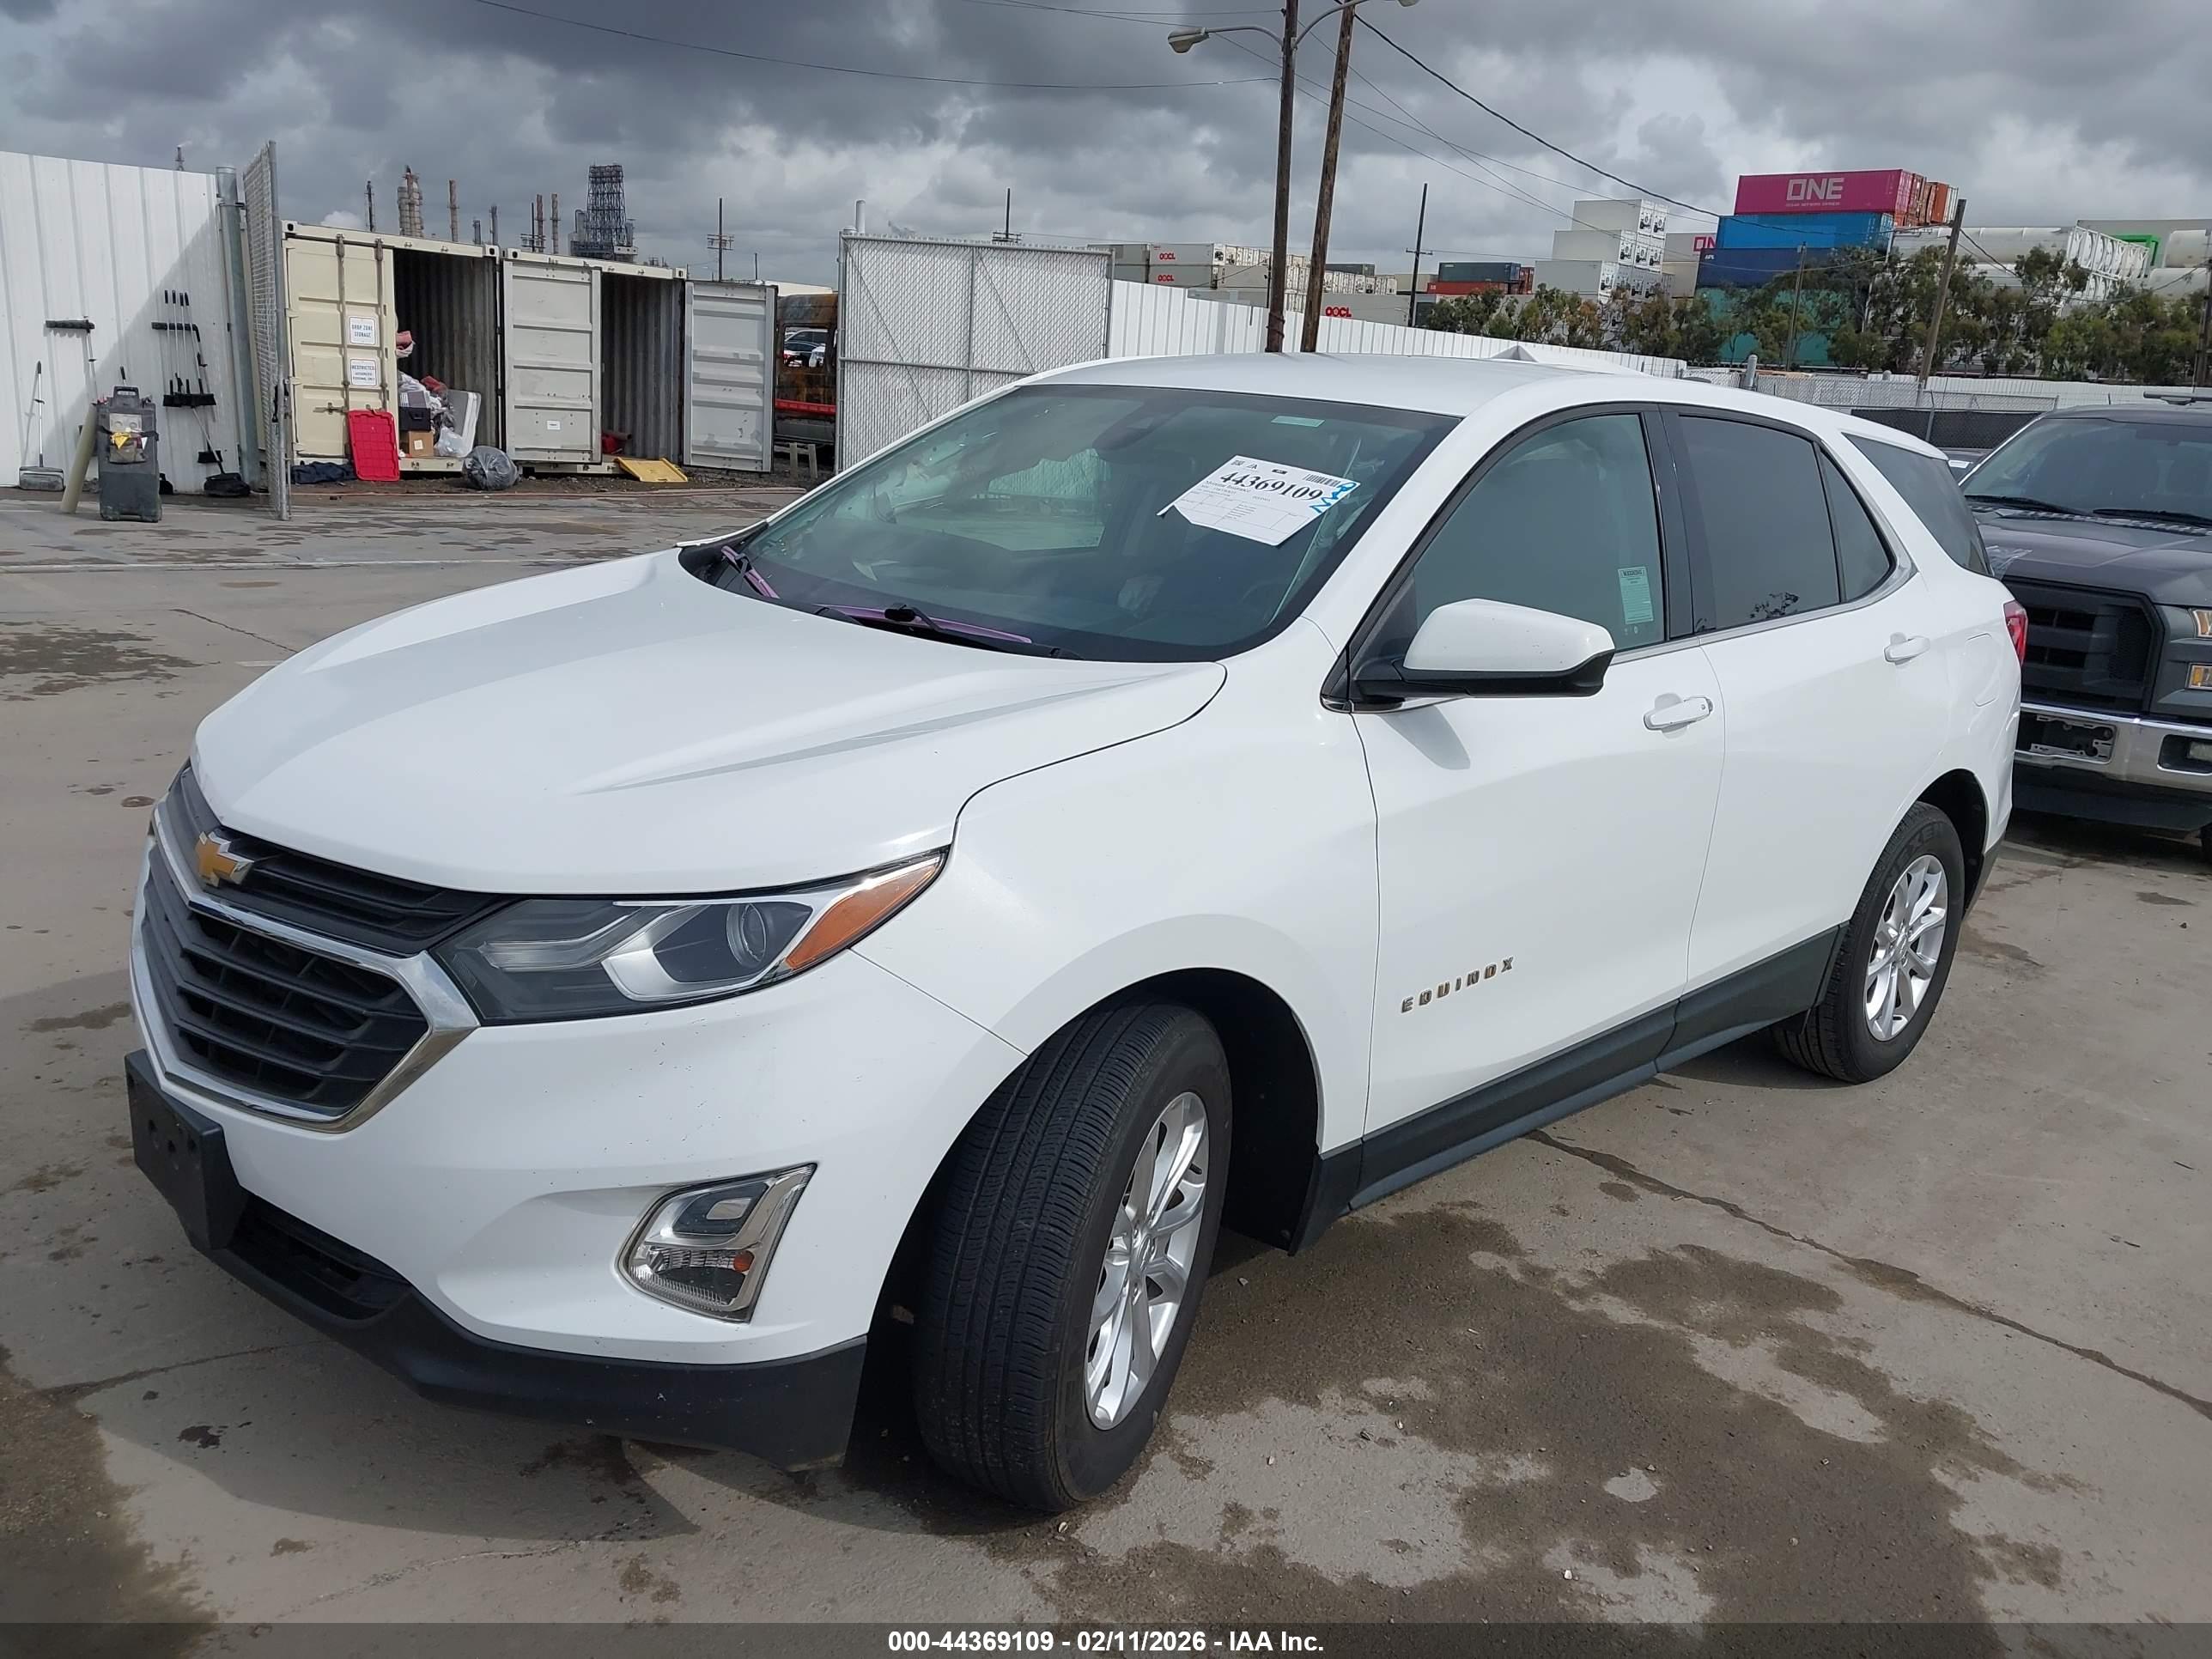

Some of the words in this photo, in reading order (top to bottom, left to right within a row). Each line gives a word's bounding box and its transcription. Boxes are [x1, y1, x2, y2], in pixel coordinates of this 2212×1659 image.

[1786, 178, 1844, 200] ONE
[1692, 236, 1716, 252] ON
[1325, 306, 1352, 318] OOCL
[1220, 471, 1324, 501] 44369109
[1401, 956, 1514, 1013] EQUINOX
